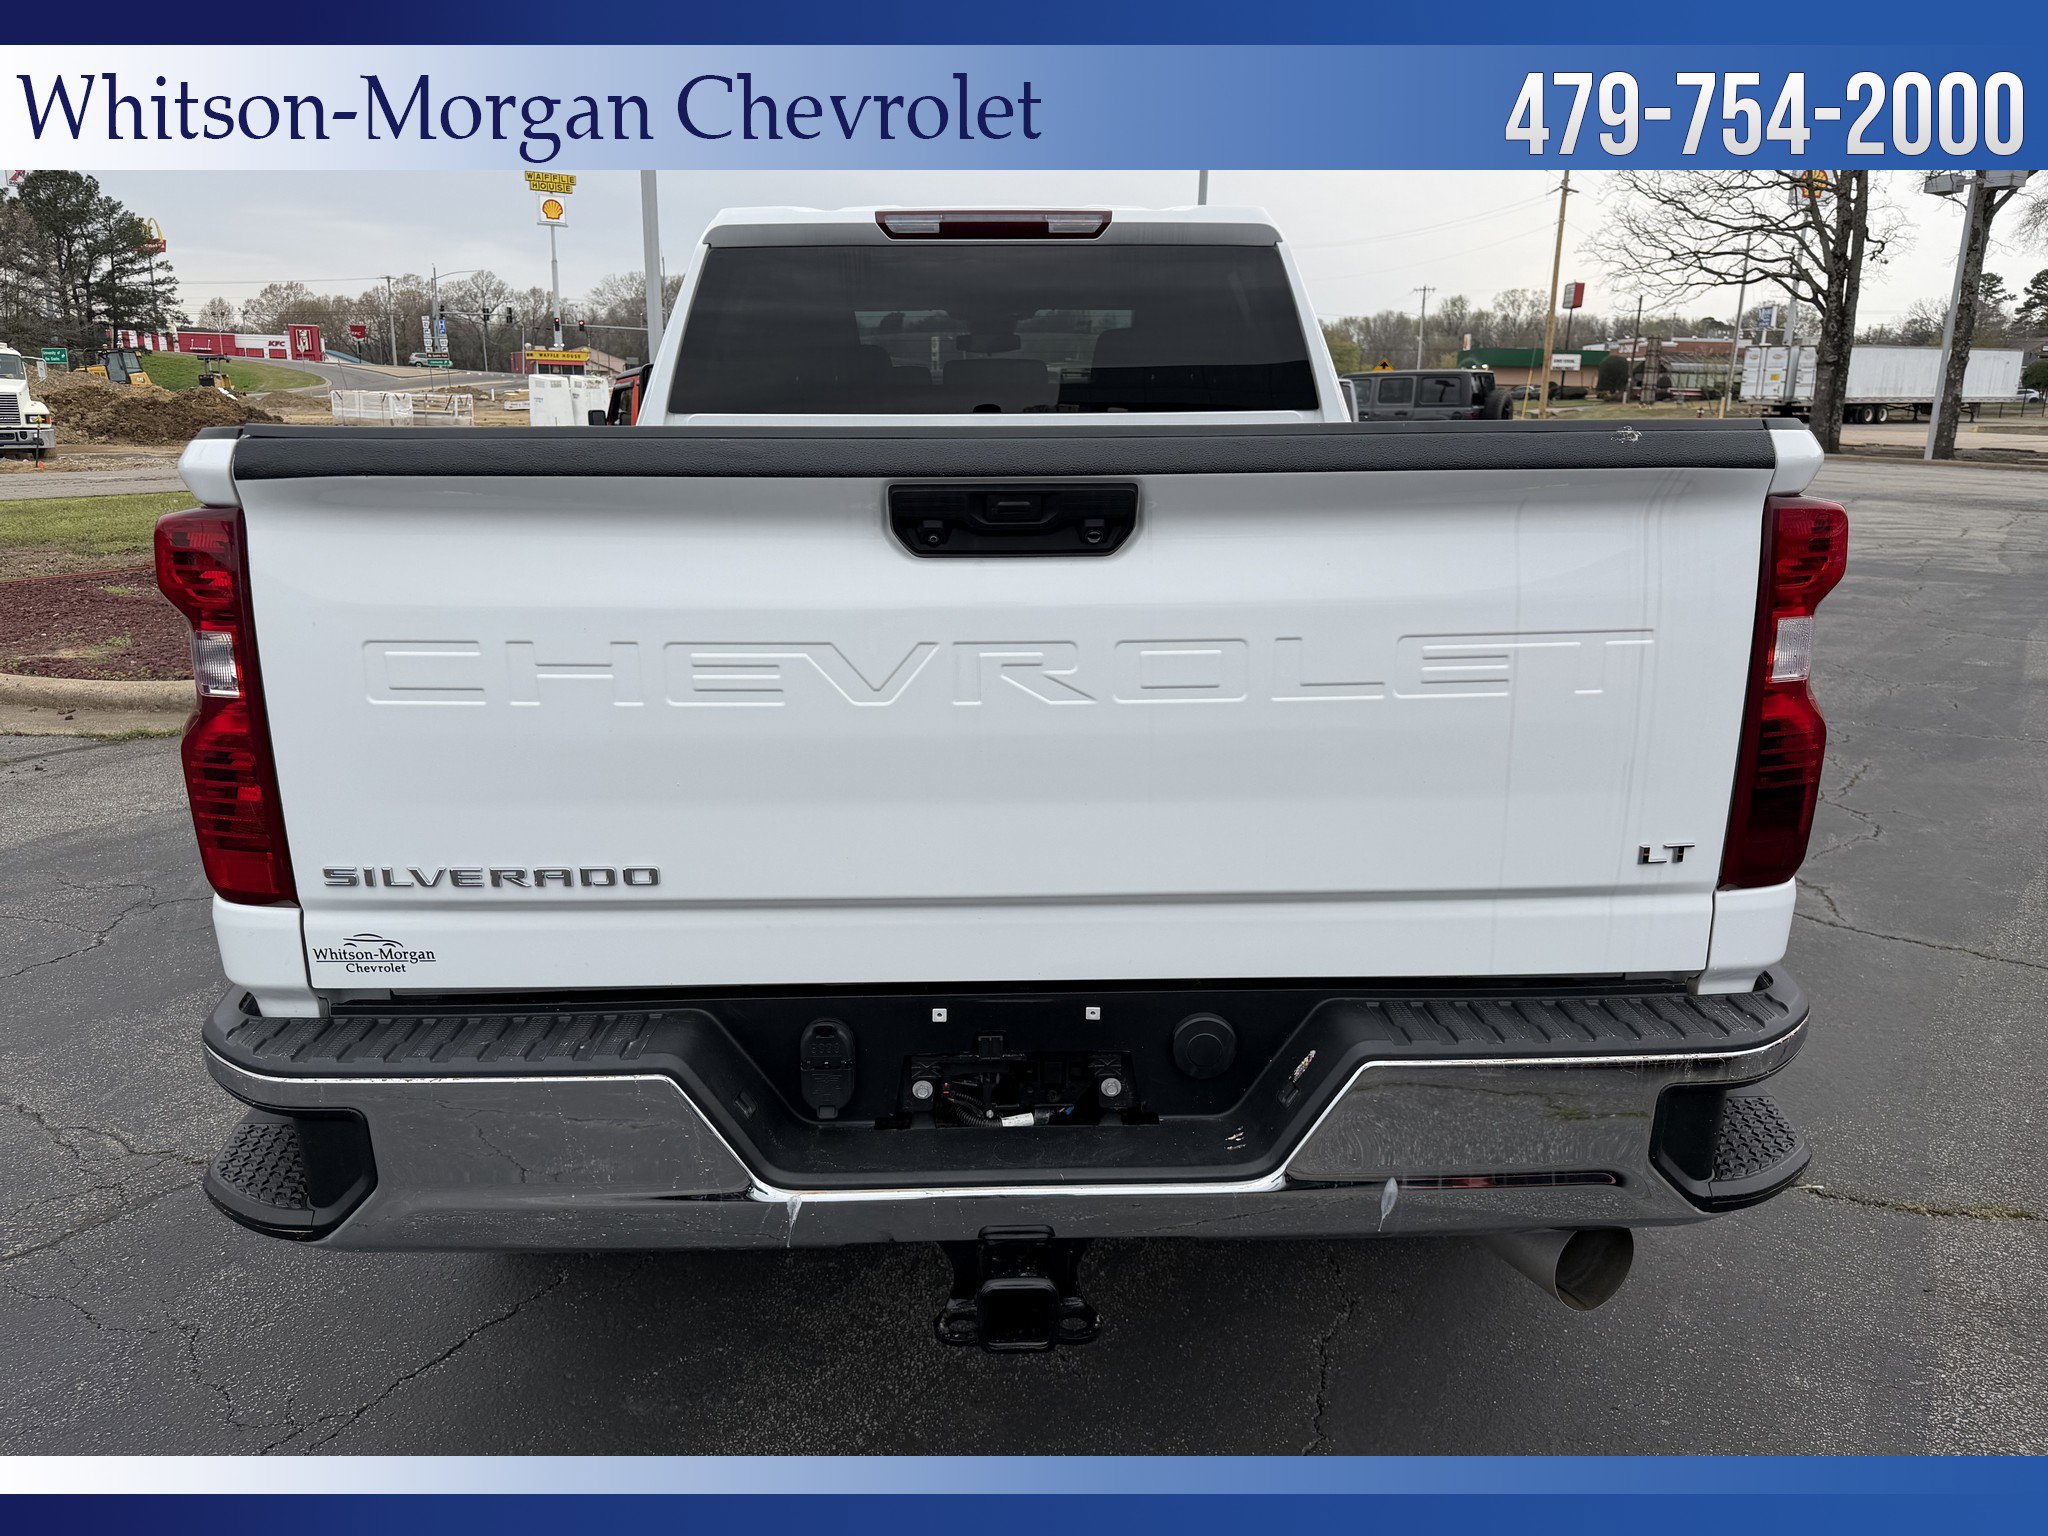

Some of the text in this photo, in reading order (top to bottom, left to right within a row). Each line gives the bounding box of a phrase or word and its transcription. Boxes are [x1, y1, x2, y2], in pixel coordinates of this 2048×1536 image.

[527, 172, 576, 184] WAFFLE
[532, 182, 572, 192] HOUSE
[361, 628, 1655, 708] CHEVROLET
[1637, 843, 1695, 865] LT
[322, 866, 662, 888] SILVERADO
[313, 947, 436, 964] Whitson-Morgan
[346, 962, 407, 973] Chevrolet
